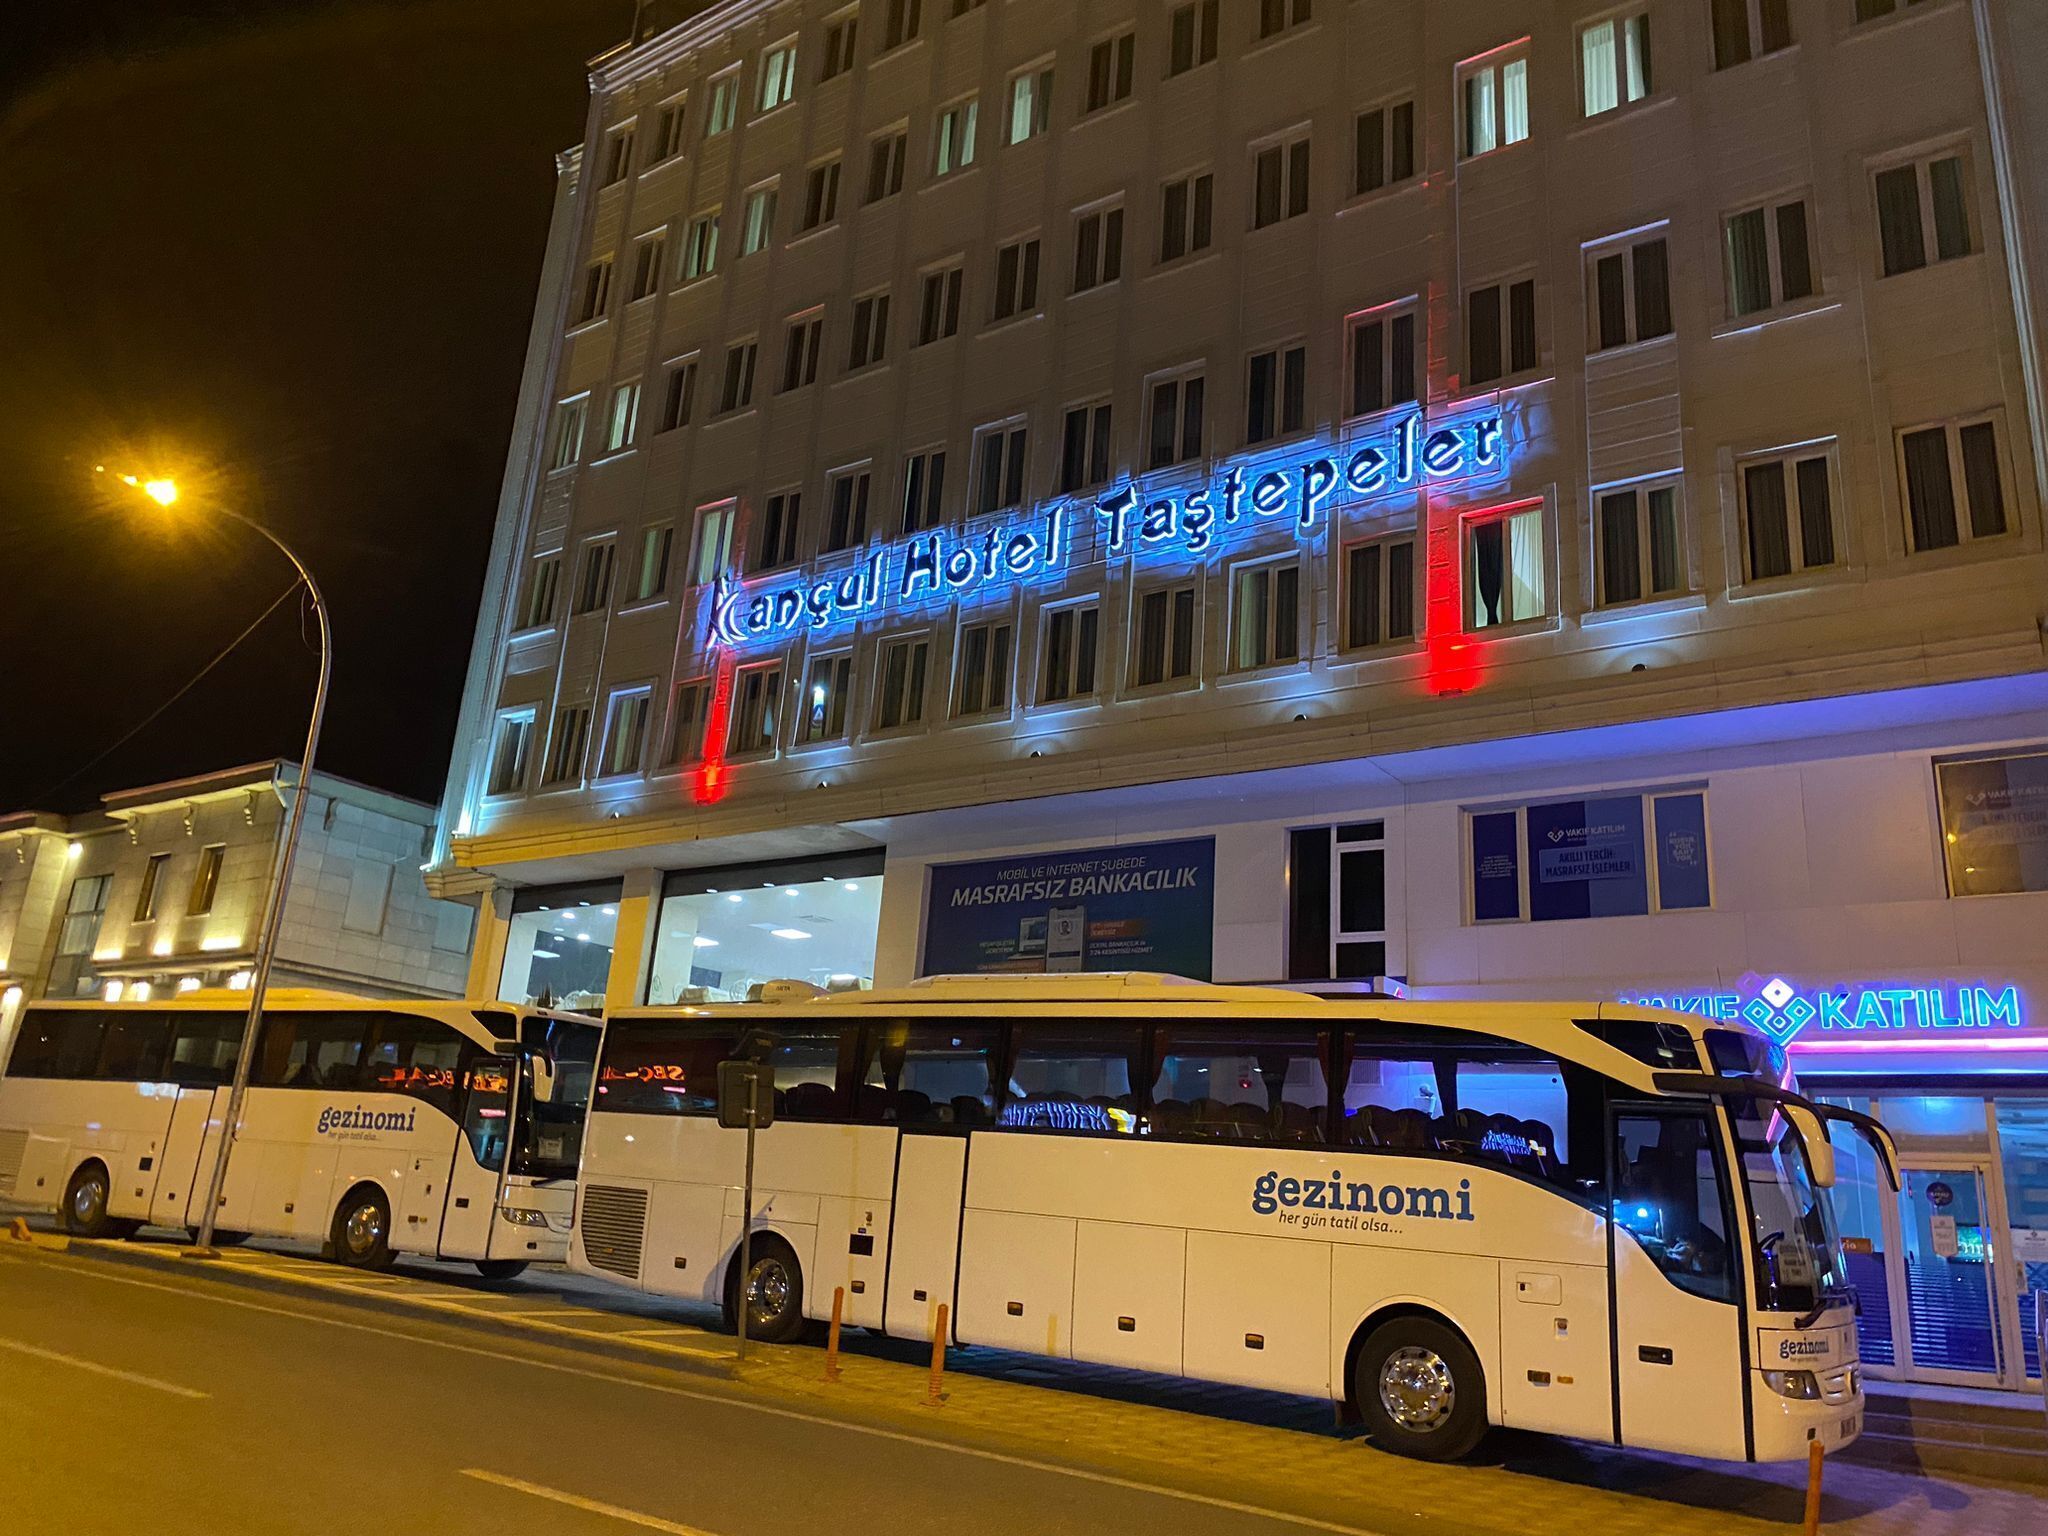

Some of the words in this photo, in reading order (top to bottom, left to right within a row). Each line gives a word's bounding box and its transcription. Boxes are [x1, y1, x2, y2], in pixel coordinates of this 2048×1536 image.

[706, 551, 883, 649] Kançul
[902, 505, 1070, 600] Hotel
[1096, 411, 1502, 549] Taştepeler
[996, 866, 1029, 881] MOBİL
[1031, 865, 1045, 878] VE
[1046, 860, 1100, 876] İNTERNET
[1101, 856, 1147, 871] ŞUBEDE
[951, 879, 1066, 907] MASRAFSIZ
[1068, 866, 1198, 897] BANKACILIK
[1819, 985, 2020, 1030] KATILIM
[317, 1104, 416, 1134] gezinomi
[1252, 1169, 1475, 1221] gezinomi
[1279, 1210, 1300, 1224] her
[1302, 1213, 1327, 1229] gün
[1330, 1215, 1358, 1230] tatil
[1779, 1336, 1830, 1359] gezinomi
